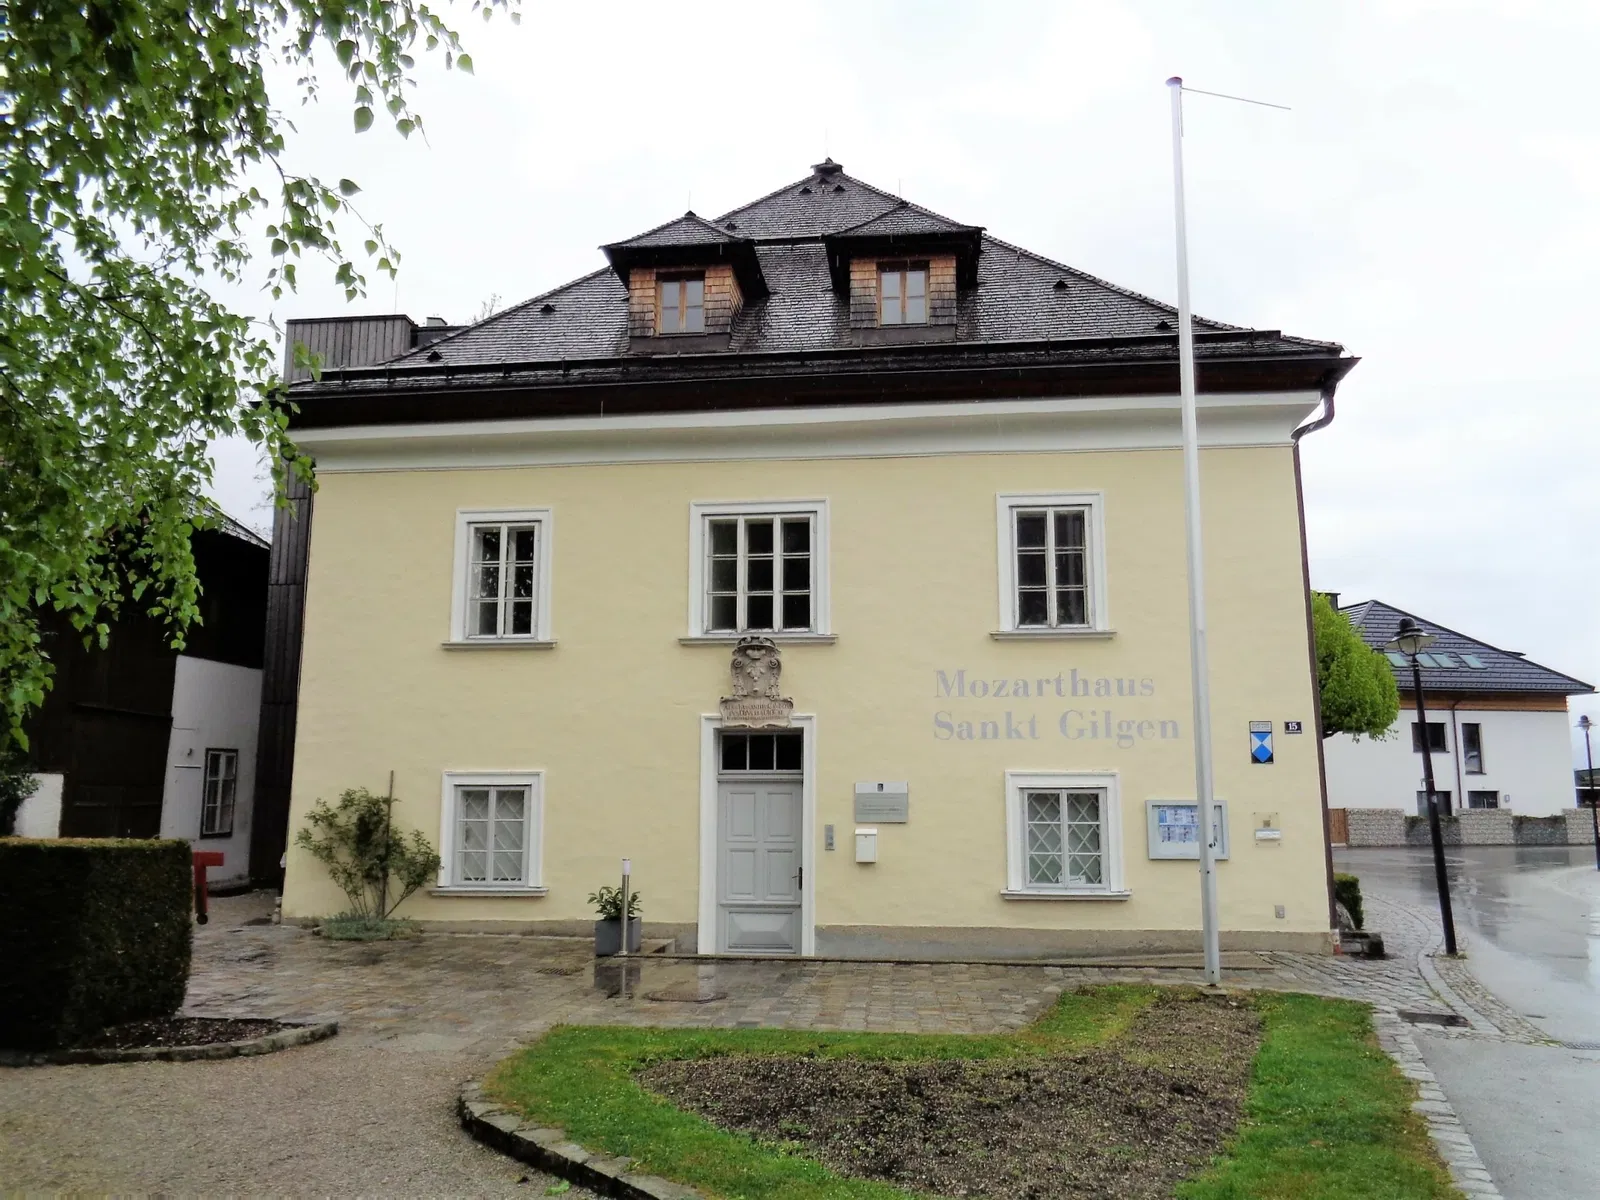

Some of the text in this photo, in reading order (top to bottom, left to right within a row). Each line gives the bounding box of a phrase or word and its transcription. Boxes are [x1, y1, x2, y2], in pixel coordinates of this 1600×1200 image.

[934, 668, 1155, 698] Mozarthaus
[933, 709, 1180, 750] Sankt Gilgen
[1288, 722, 1298, 731] 15
